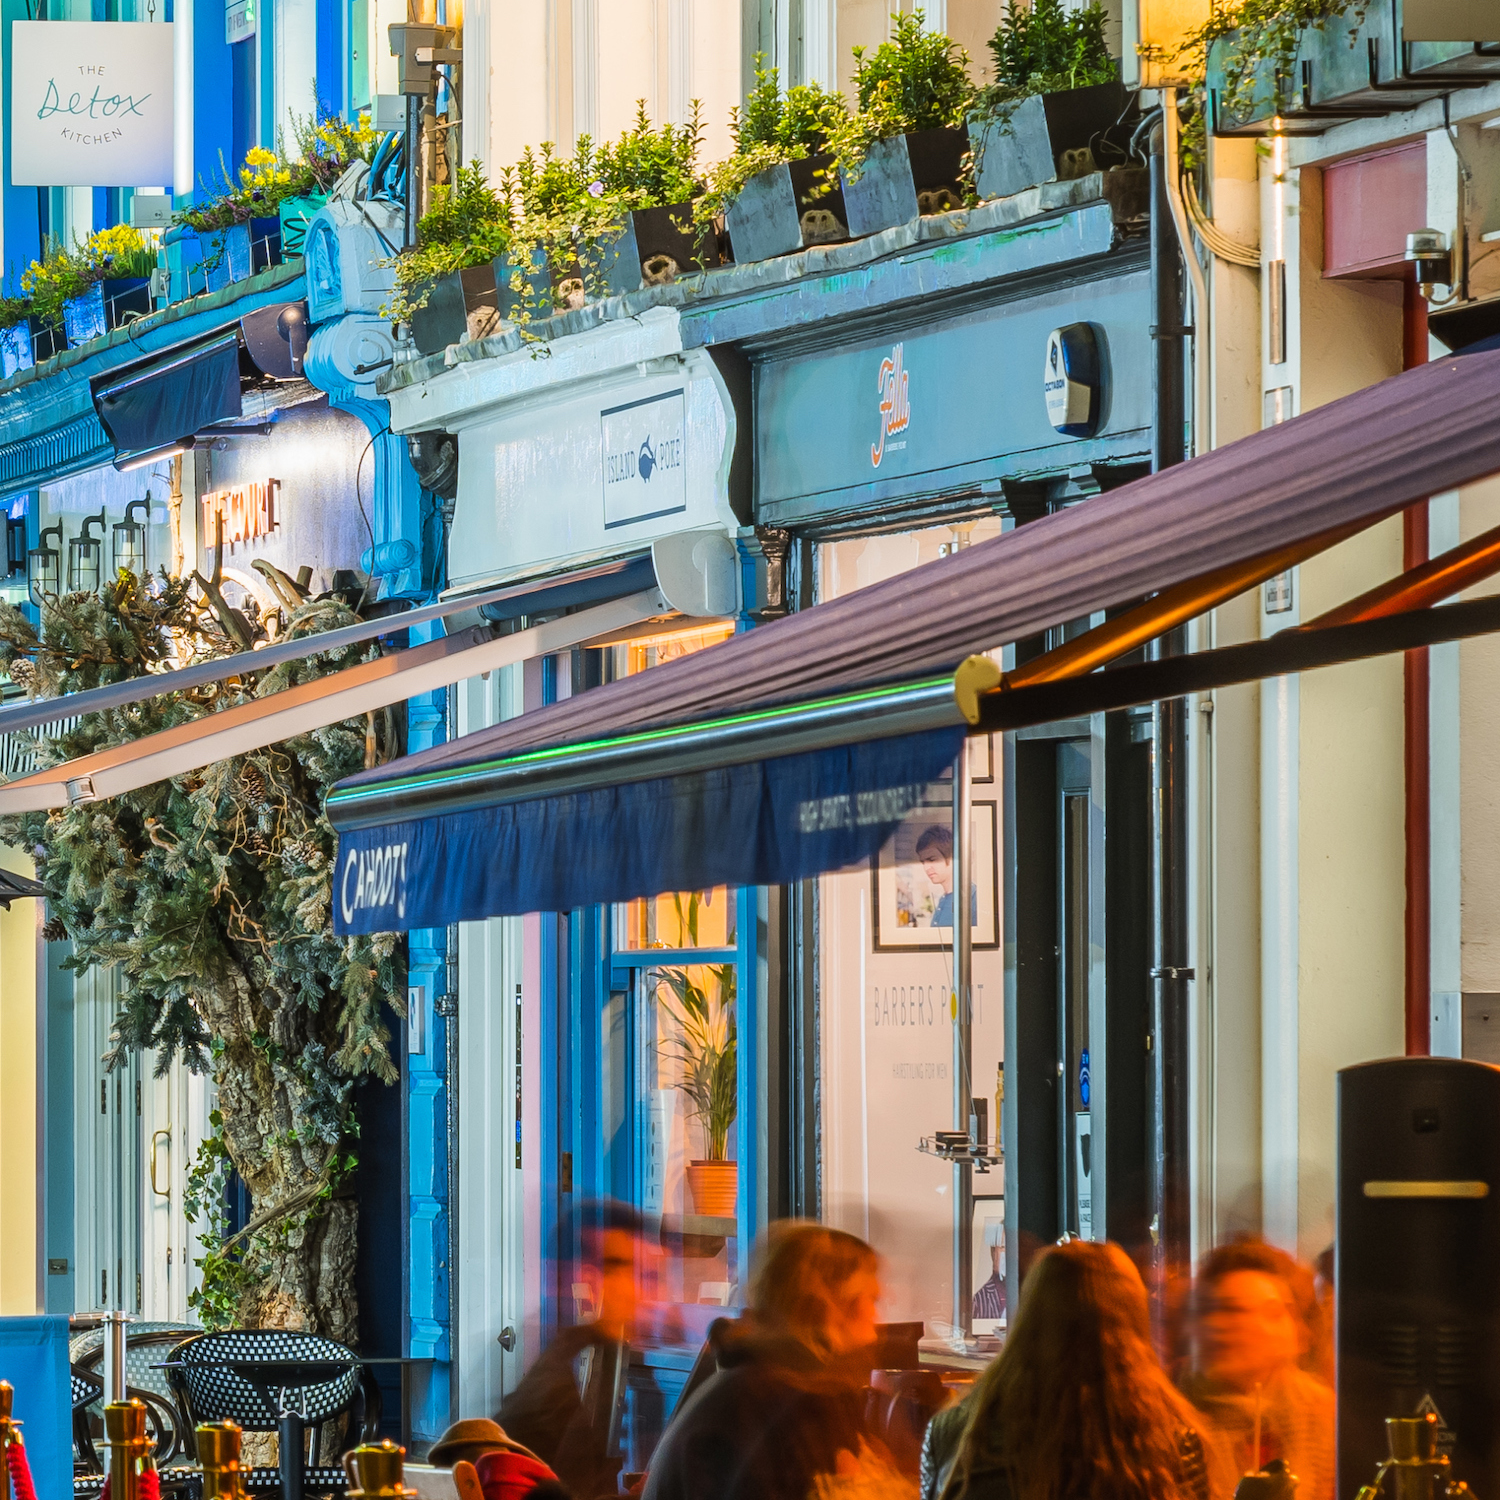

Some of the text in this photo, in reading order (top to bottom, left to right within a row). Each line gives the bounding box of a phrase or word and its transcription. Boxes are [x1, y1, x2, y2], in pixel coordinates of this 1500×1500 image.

[78, 66, 106, 76] THE
[37, 77, 153, 120] Detox
[61, 127, 123, 145] KITCHEN
[871, 342, 910, 468] Fella
[607, 450, 636, 484] ISLAND
[341, 842, 407, 925] CAHOOTS
[874, 985, 934, 1027] BARBERS
